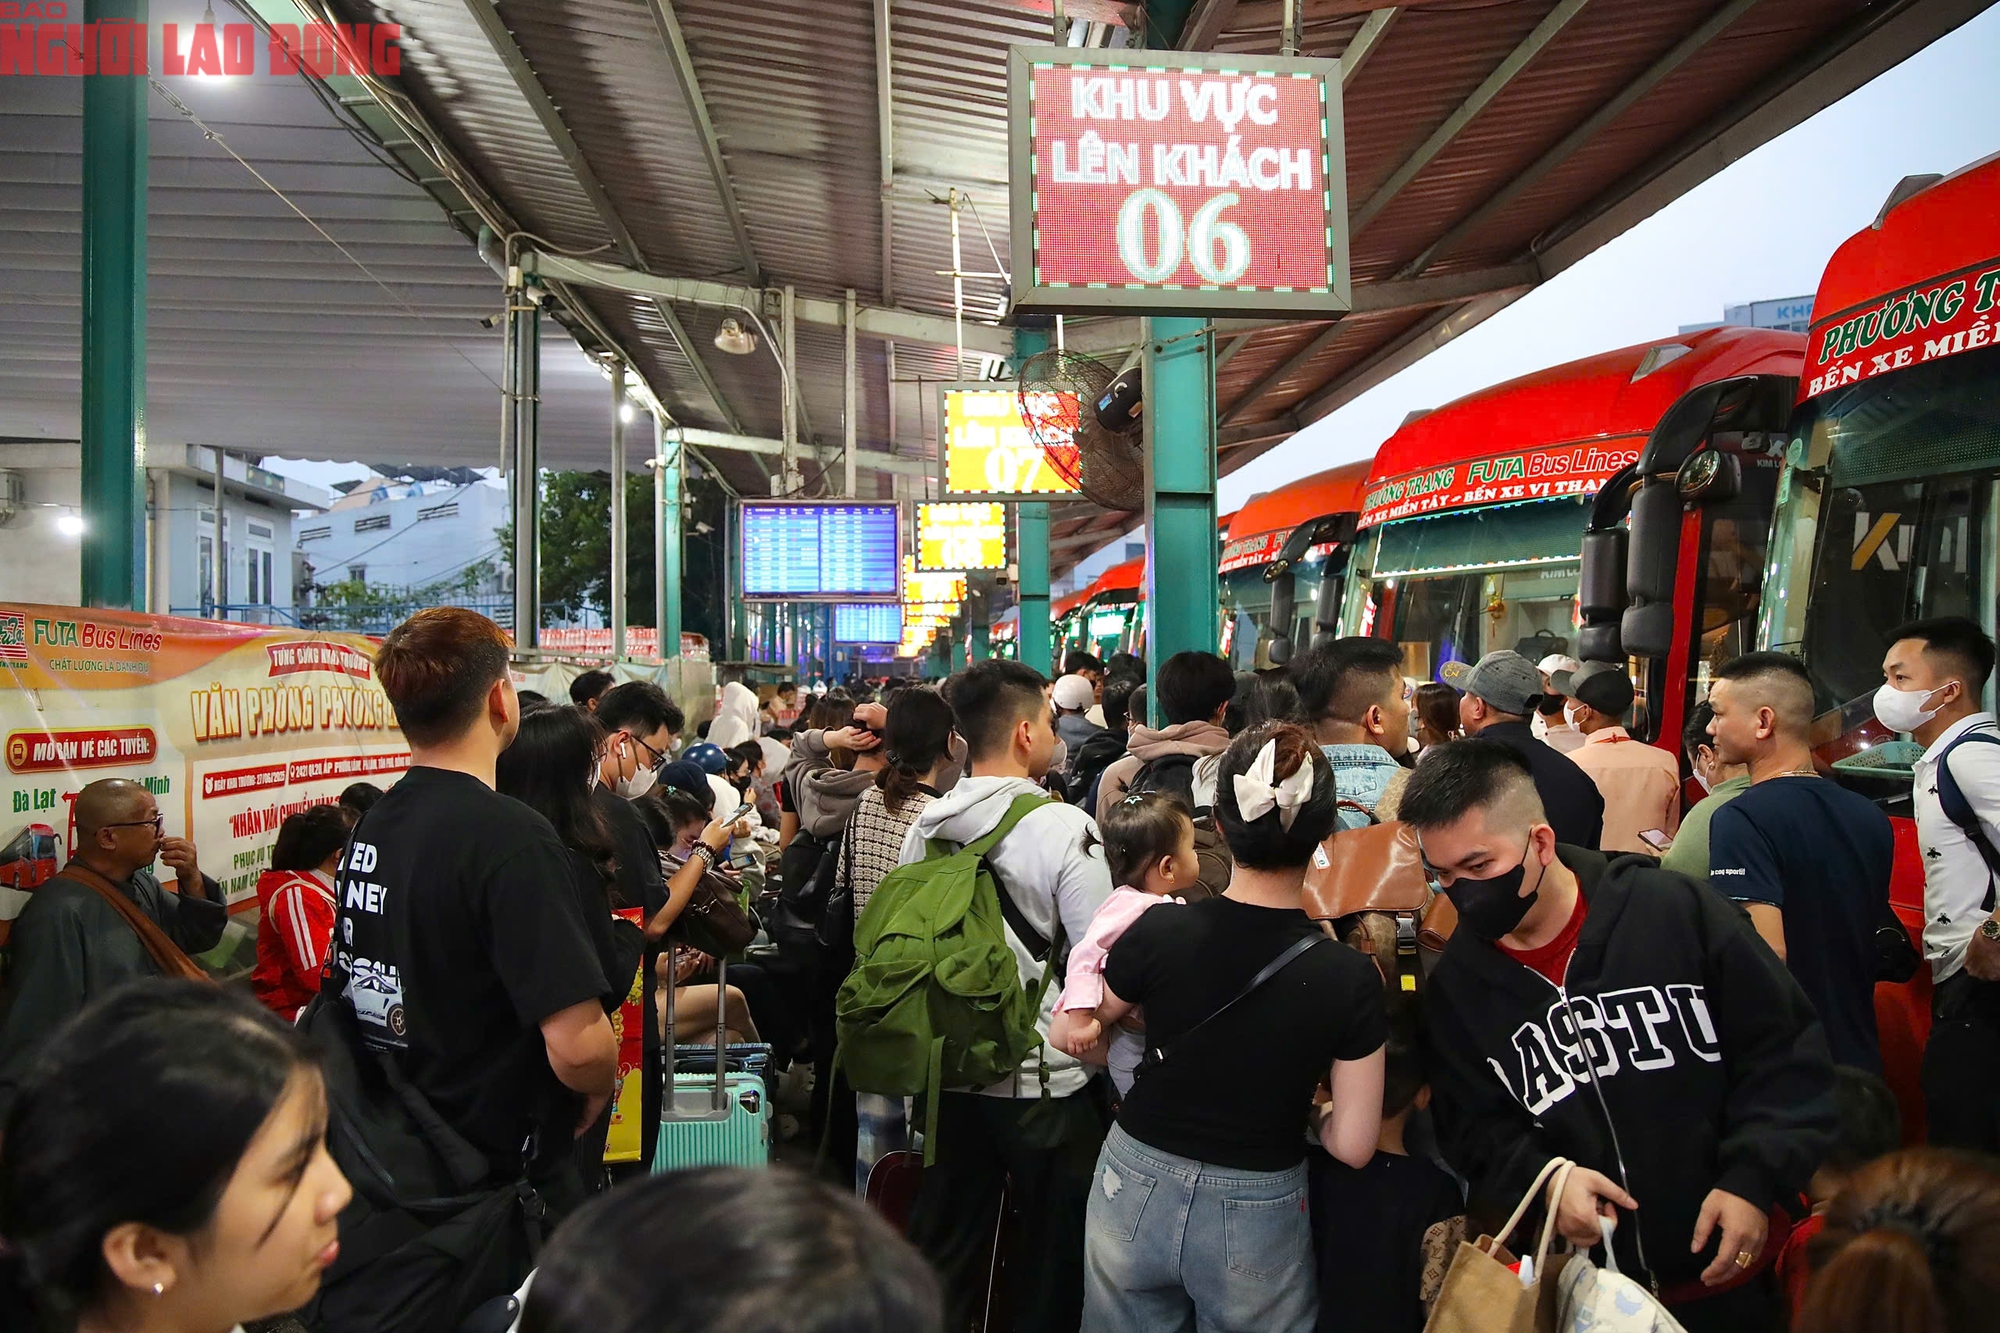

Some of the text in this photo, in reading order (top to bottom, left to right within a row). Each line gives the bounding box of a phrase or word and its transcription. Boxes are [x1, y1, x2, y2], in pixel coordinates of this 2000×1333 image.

[1071, 76, 1278, 132] KHU VỰC
[1052, 130, 1312, 190] LÊN KHÁCH
[1116, 188, 1250, 283] 06
[1818, 268, 2000, 365] PHƯƠNG T
[1807, 359, 1864, 398] BẾN
[1868, 345, 1914, 375] XE
[985, 447, 1045, 493] 07
[1406, 467, 1455, 498] TRANG
[1466, 448, 1639, 486] FUTA Bus Lines
[1374, 508, 1388, 520] XE
[1420, 494, 1450, 510] TÂY
[1463, 484, 1497, 502] BẾN
[1500, 484, 1524, 498] XE
[1529, 481, 1550, 496] VỊ
[34, 619, 163, 652] FUTA Bus Lines
[50, 657, 71, 671] CHẤT
[73, 659, 102, 673] LƯỢNG
[104, 658, 114, 671] LÀ
[116, 662, 137, 672] DANH
[190, 681, 242, 742] VĂN
[246, 681, 314, 736] PHÒNG
[320, 683, 384, 730] PHƯƠNG
[81, 737, 95, 758] VÉ
[97, 737, 117, 758] CÁC
[120, 732, 150, 755] TUYẾN:
[13, 788, 57, 813] Đà Lạt
[233, 850, 255, 870] PHỤC
[338, 842, 378, 874] ED
[231, 874, 248, 894] NAM
[336, 879, 388, 915] NEY
[1486, 984, 1722, 1117] ASTU
